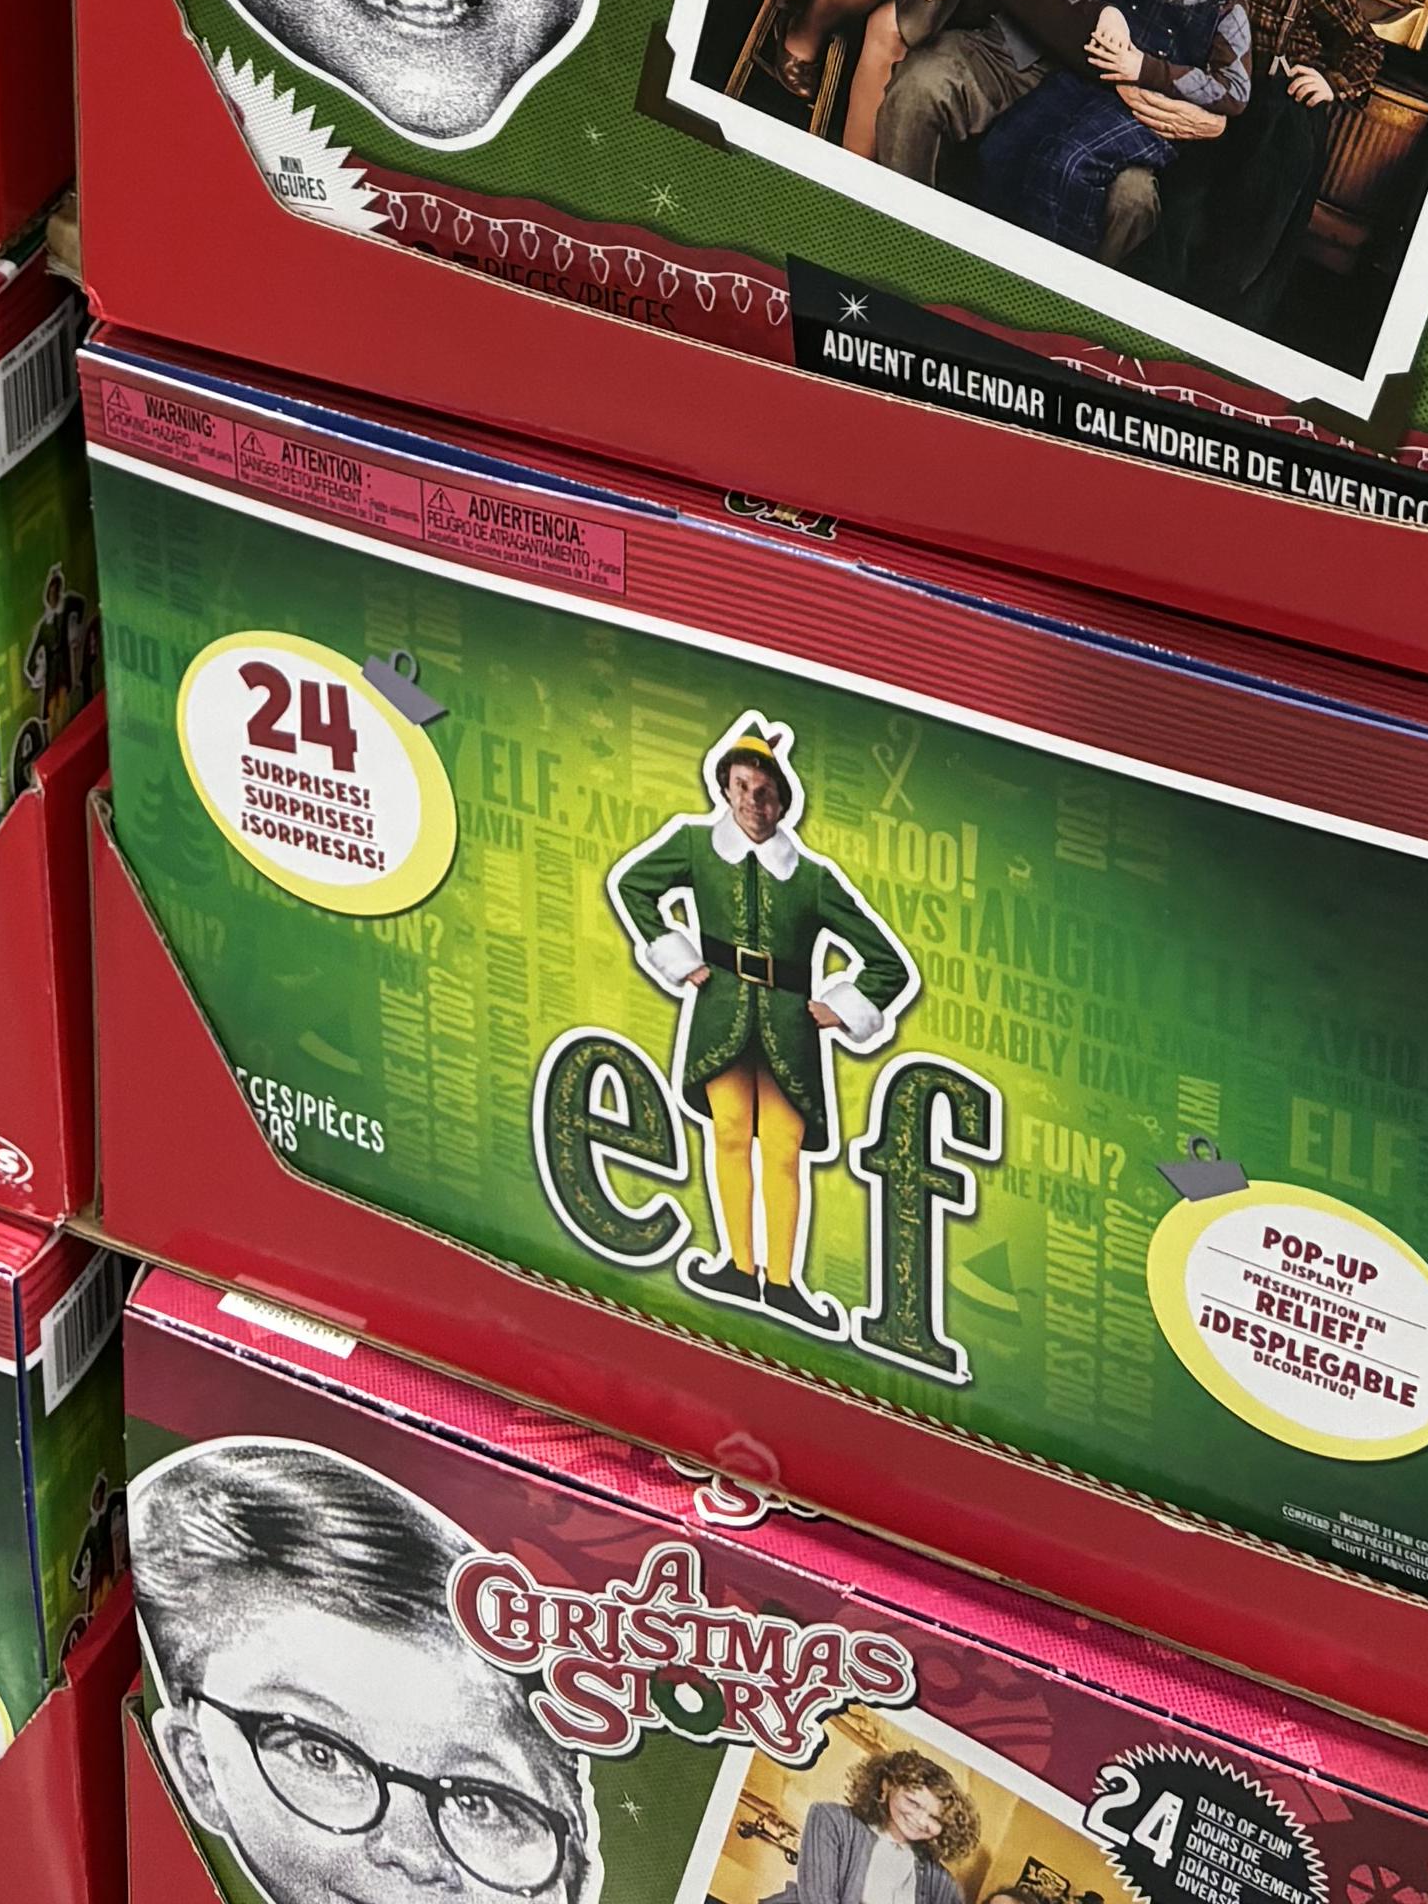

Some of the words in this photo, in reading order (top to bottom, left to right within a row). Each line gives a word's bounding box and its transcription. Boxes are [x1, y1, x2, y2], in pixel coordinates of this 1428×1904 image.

[823, 329, 916, 381] ADVENT
[921, 357, 1045, 420] CALENDAR
[1075, 402, 1241, 477] CALENDRIER
[1246, 449, 1284, 486] DE
[238, 661, 358, 773] 24
[1262, 1226, 1379, 1285] POP-UP
[1199, 1305, 1418, 1409] ¡DESPLEGABLE
[1256, 1290, 1367, 1350] RELIEF!
[456, 1558, 908, 1695] CHRISTMAS
[621, 1548, 694, 1606] A
[540, 1665, 824, 1761] STORY
